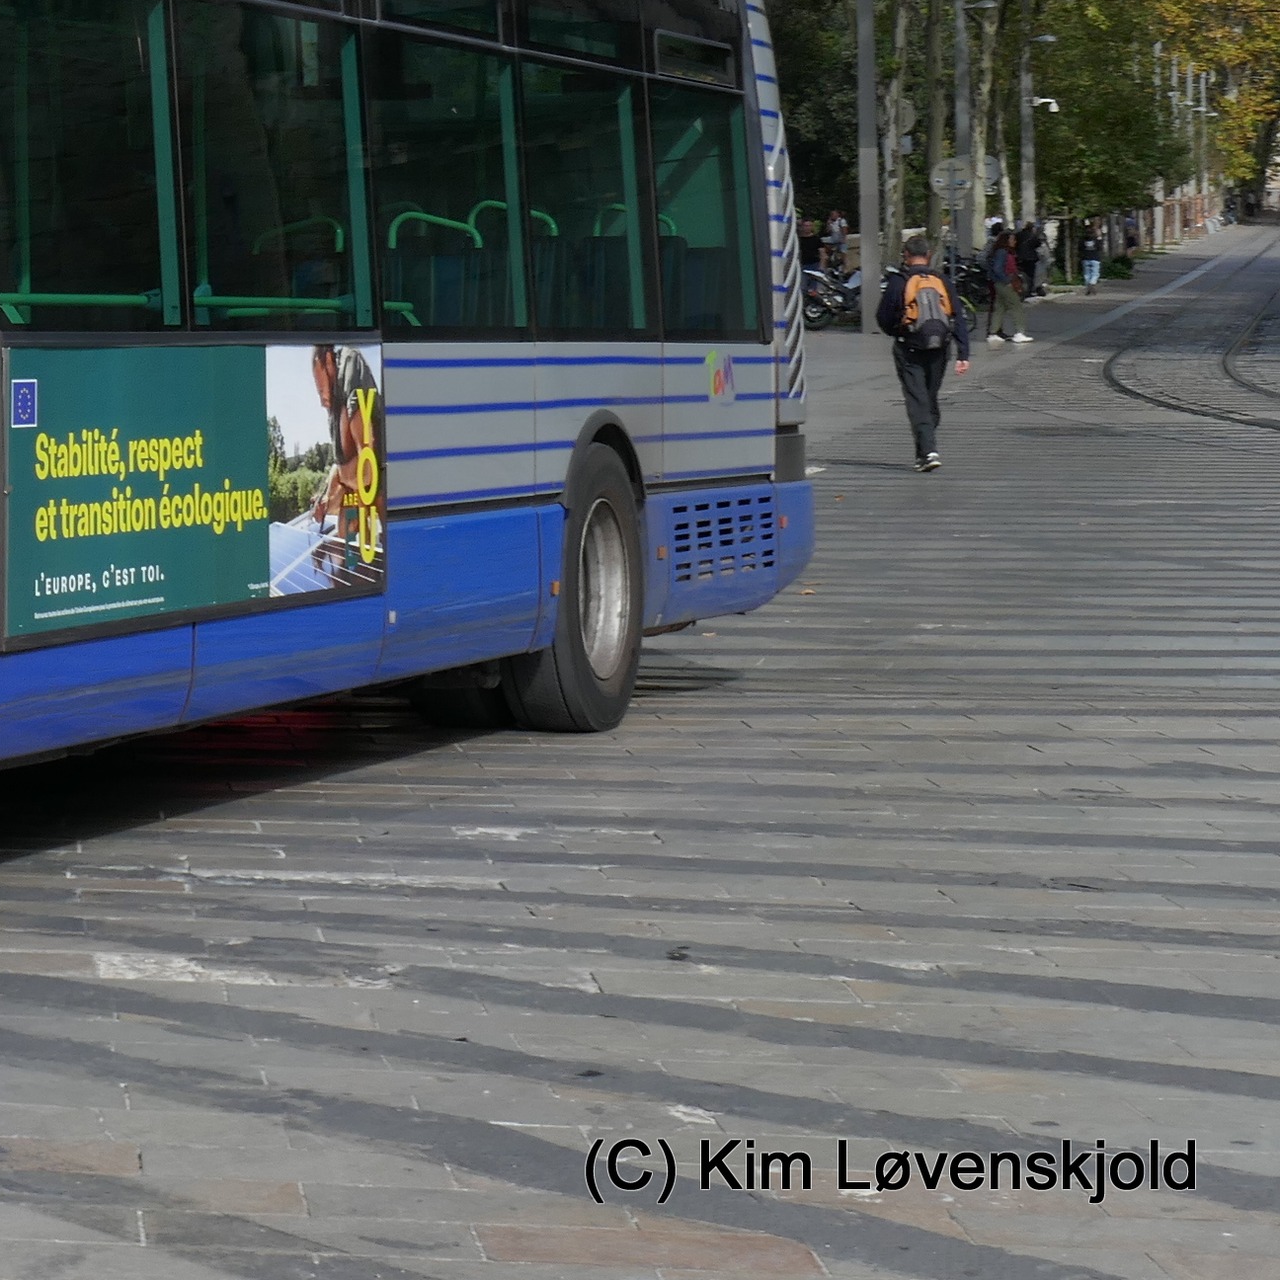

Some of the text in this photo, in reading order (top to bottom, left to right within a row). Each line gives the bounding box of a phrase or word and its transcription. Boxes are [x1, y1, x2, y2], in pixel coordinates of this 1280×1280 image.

[35, 428, 203, 481] Stabilité, respect
[356, 388, 378, 564] YOU
[35, 478, 268, 542] et transition écologique.
[343, 493, 358, 507] ARE
[34, 564, 165, 597] L'EUROPE, C'EST TOI.
